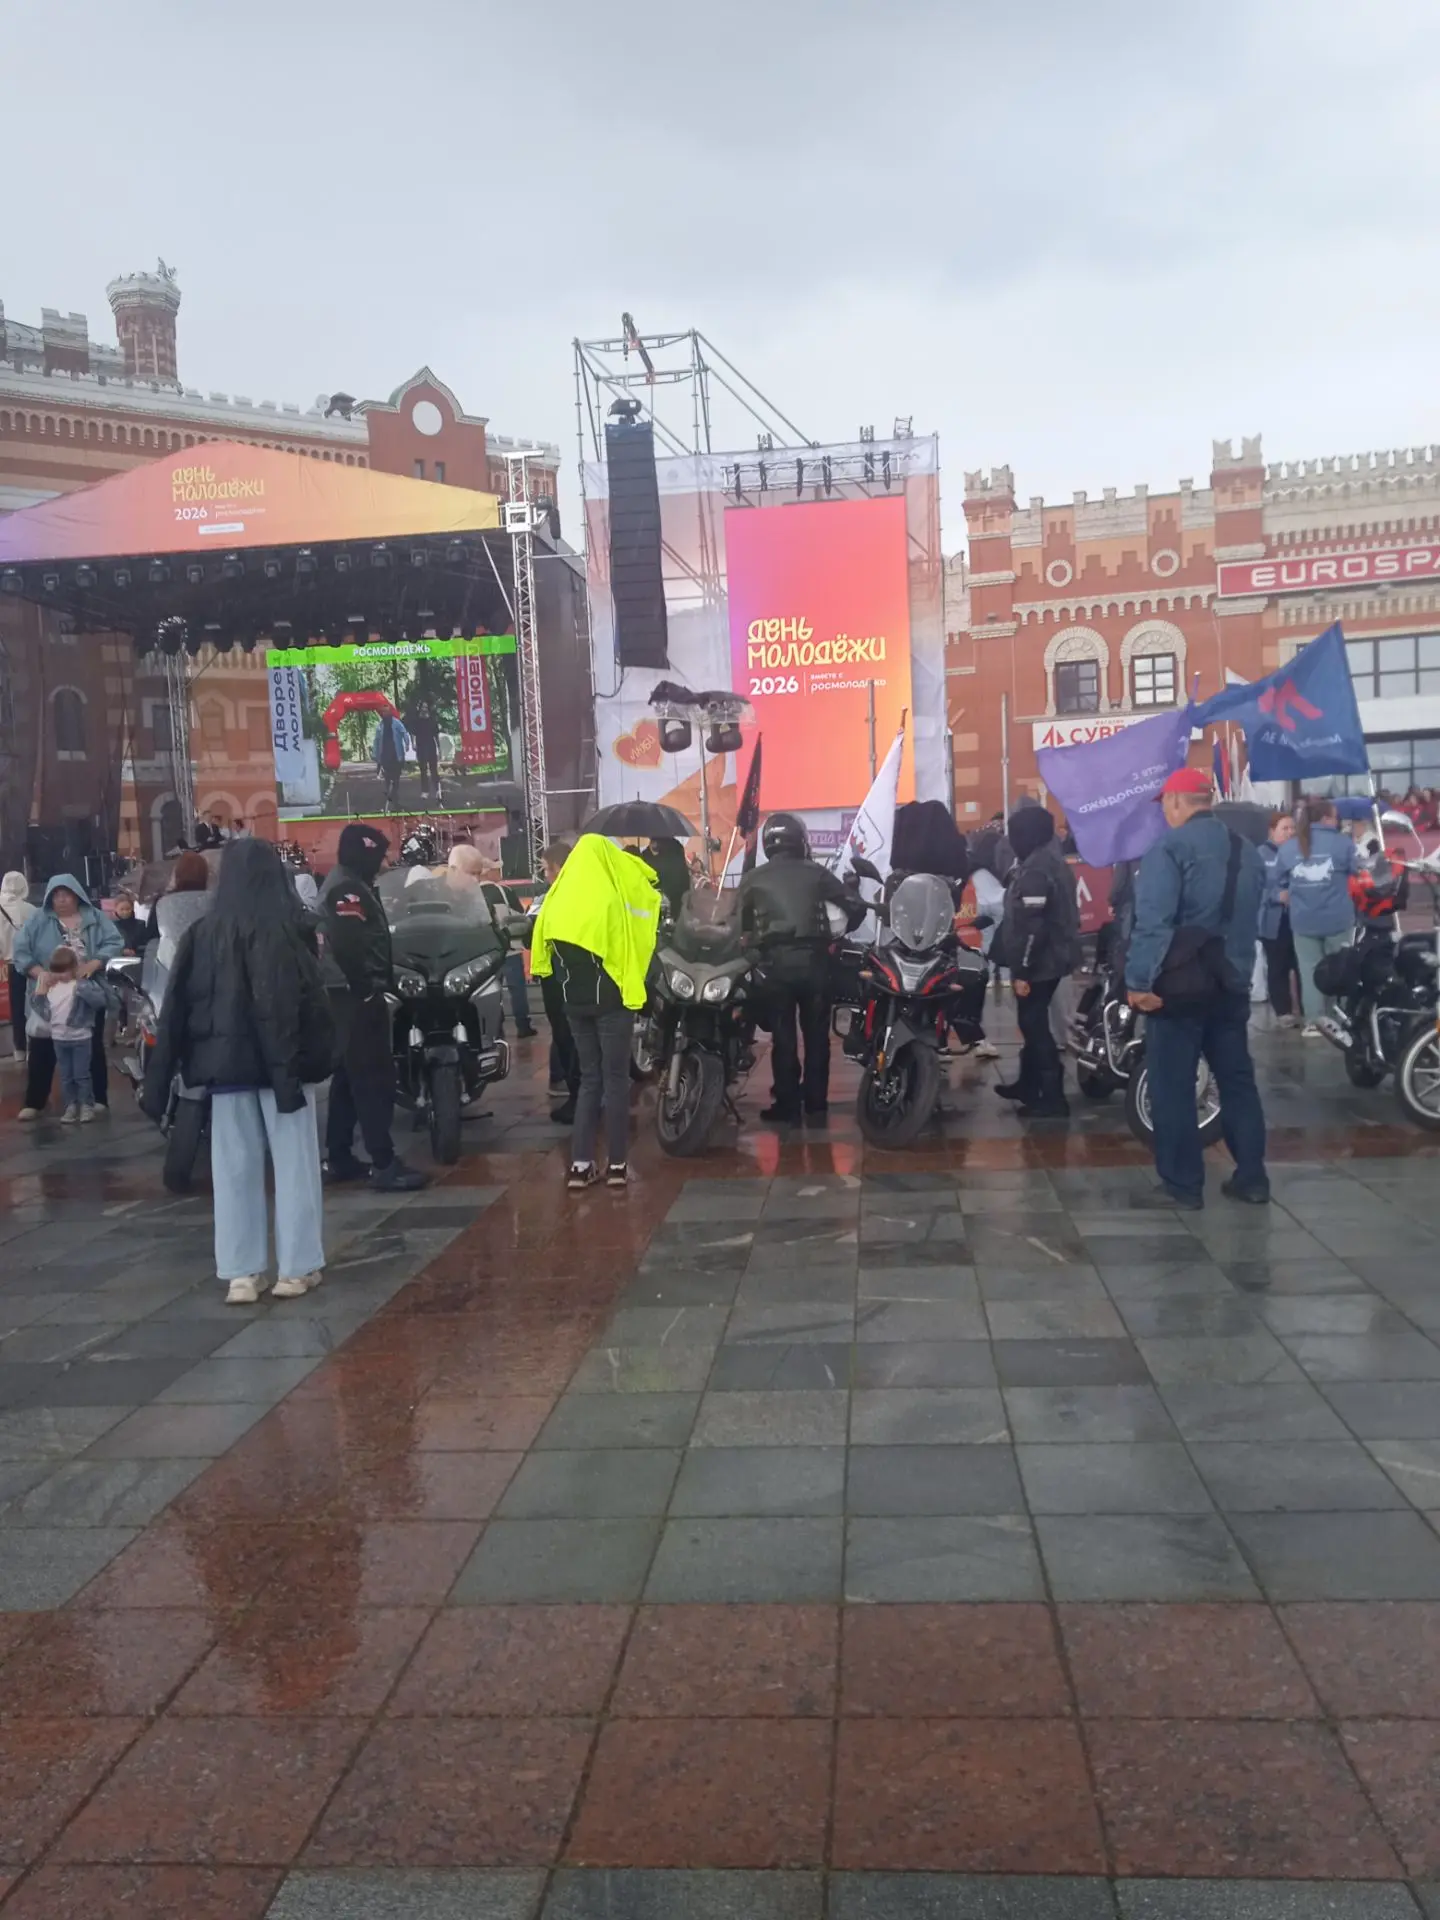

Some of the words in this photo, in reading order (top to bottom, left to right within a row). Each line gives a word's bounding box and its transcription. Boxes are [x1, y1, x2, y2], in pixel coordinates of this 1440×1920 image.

[175, 506, 208, 520] 2026
[1251, 550, 1440, 587] EUROSP
[749, 676, 799, 695] 2026
